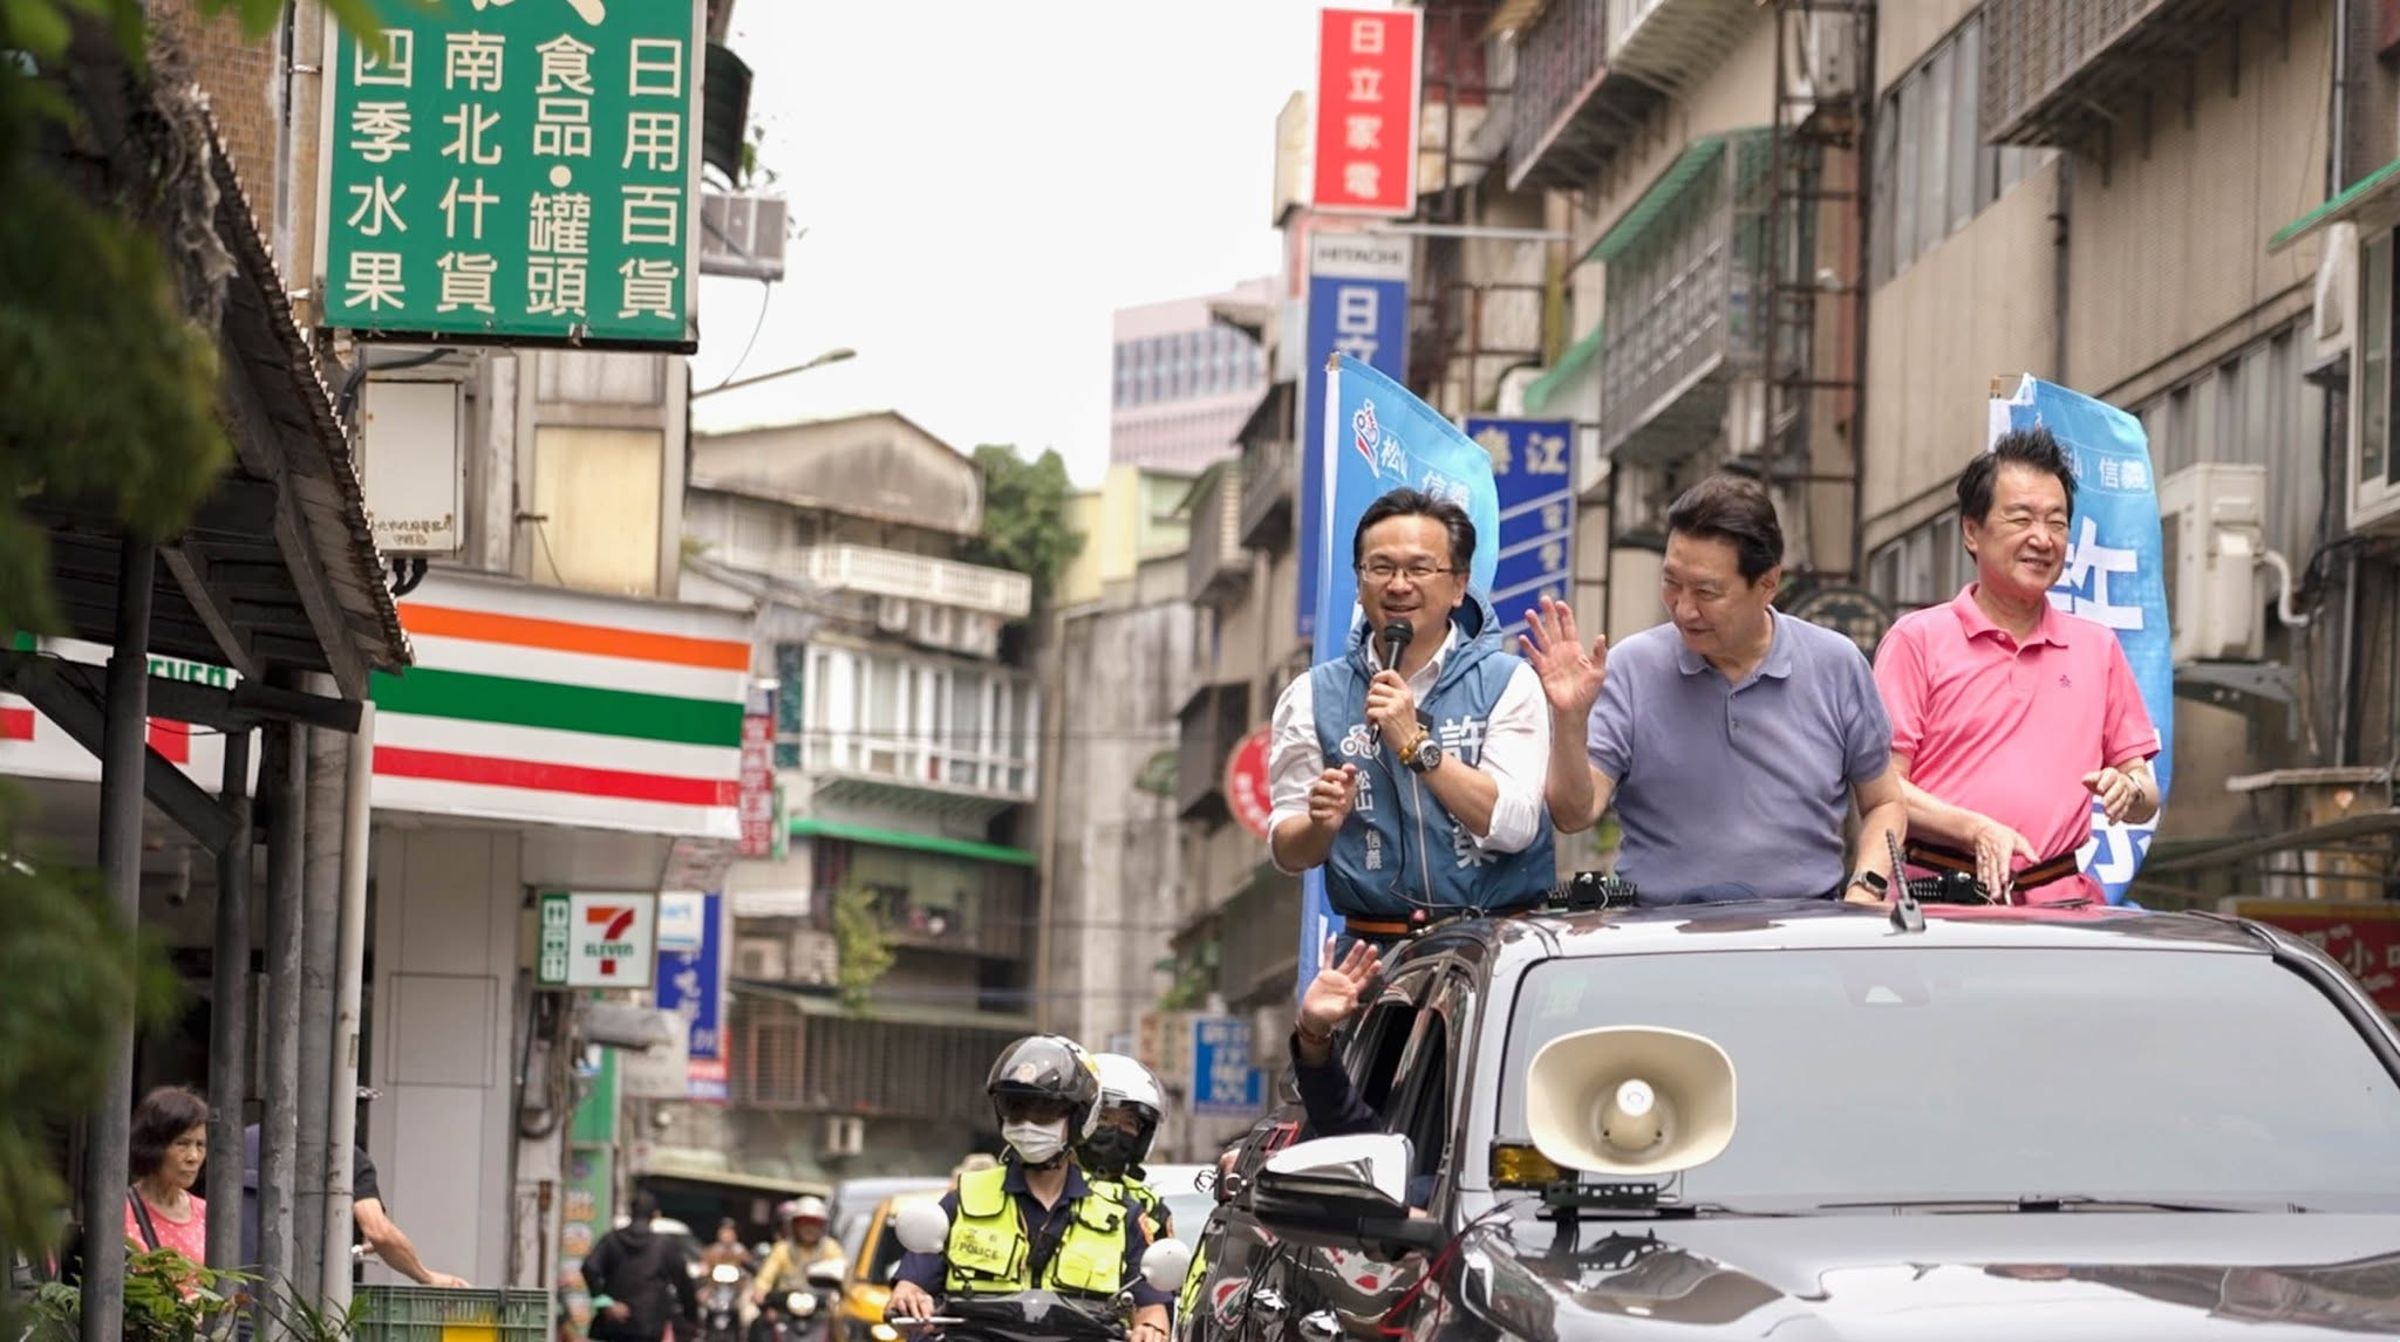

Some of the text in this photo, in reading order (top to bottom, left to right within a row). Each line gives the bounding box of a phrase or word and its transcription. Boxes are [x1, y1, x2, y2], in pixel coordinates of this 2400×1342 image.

[344, 28, 414, 312] 四季水果
[436, 30, 506, 314] 南北什貨
[618, 38, 683, 320] 日用百貨
[1438, 714, 1487, 767] 許
[586, 906, 635, 941] 7
[958, 1241, 999, 1261] POLICE
